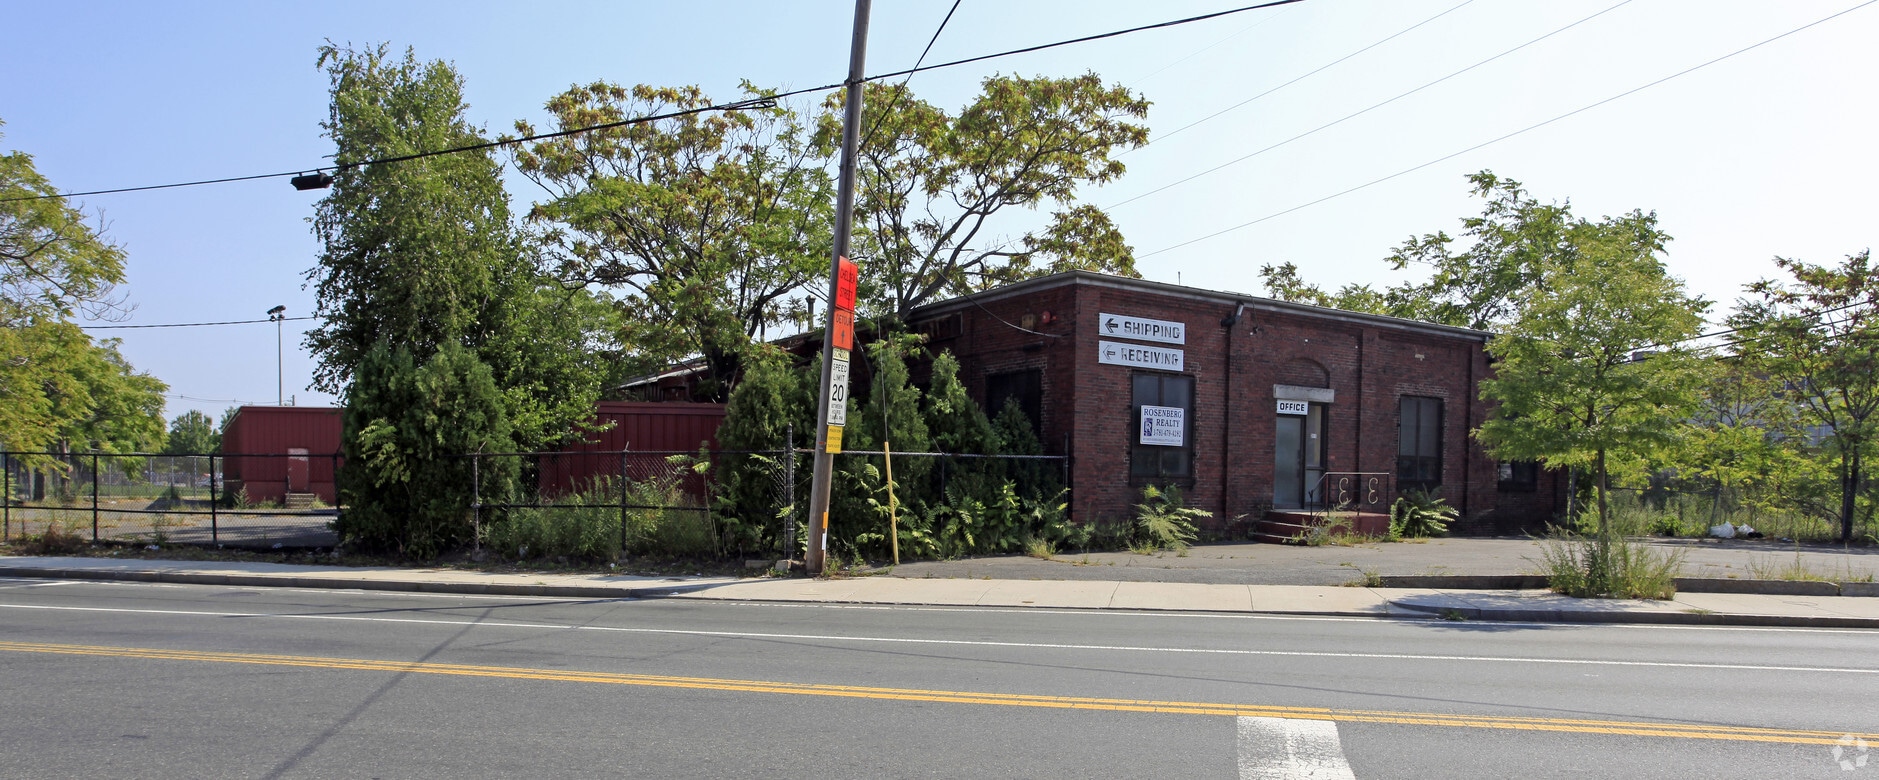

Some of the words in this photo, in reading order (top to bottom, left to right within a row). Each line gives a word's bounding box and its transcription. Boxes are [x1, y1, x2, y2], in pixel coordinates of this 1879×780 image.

[840, 287, 853, 300] STREET
[836, 313, 852, 326] DETOUR
[1124, 321, 1180, 339] SHIPPING
[834, 349, 848, 360] SCHOOL
[1121, 347, 1179, 366] RECEIVING
[833, 363, 847, 373] SPEED
[832, 383, 844, 402] 20
[1144, 408, 1182, 418] ROSENBERG
[1280, 402, 1305, 412] OFFICE
[1156, 418, 1180, 428] REALTY
